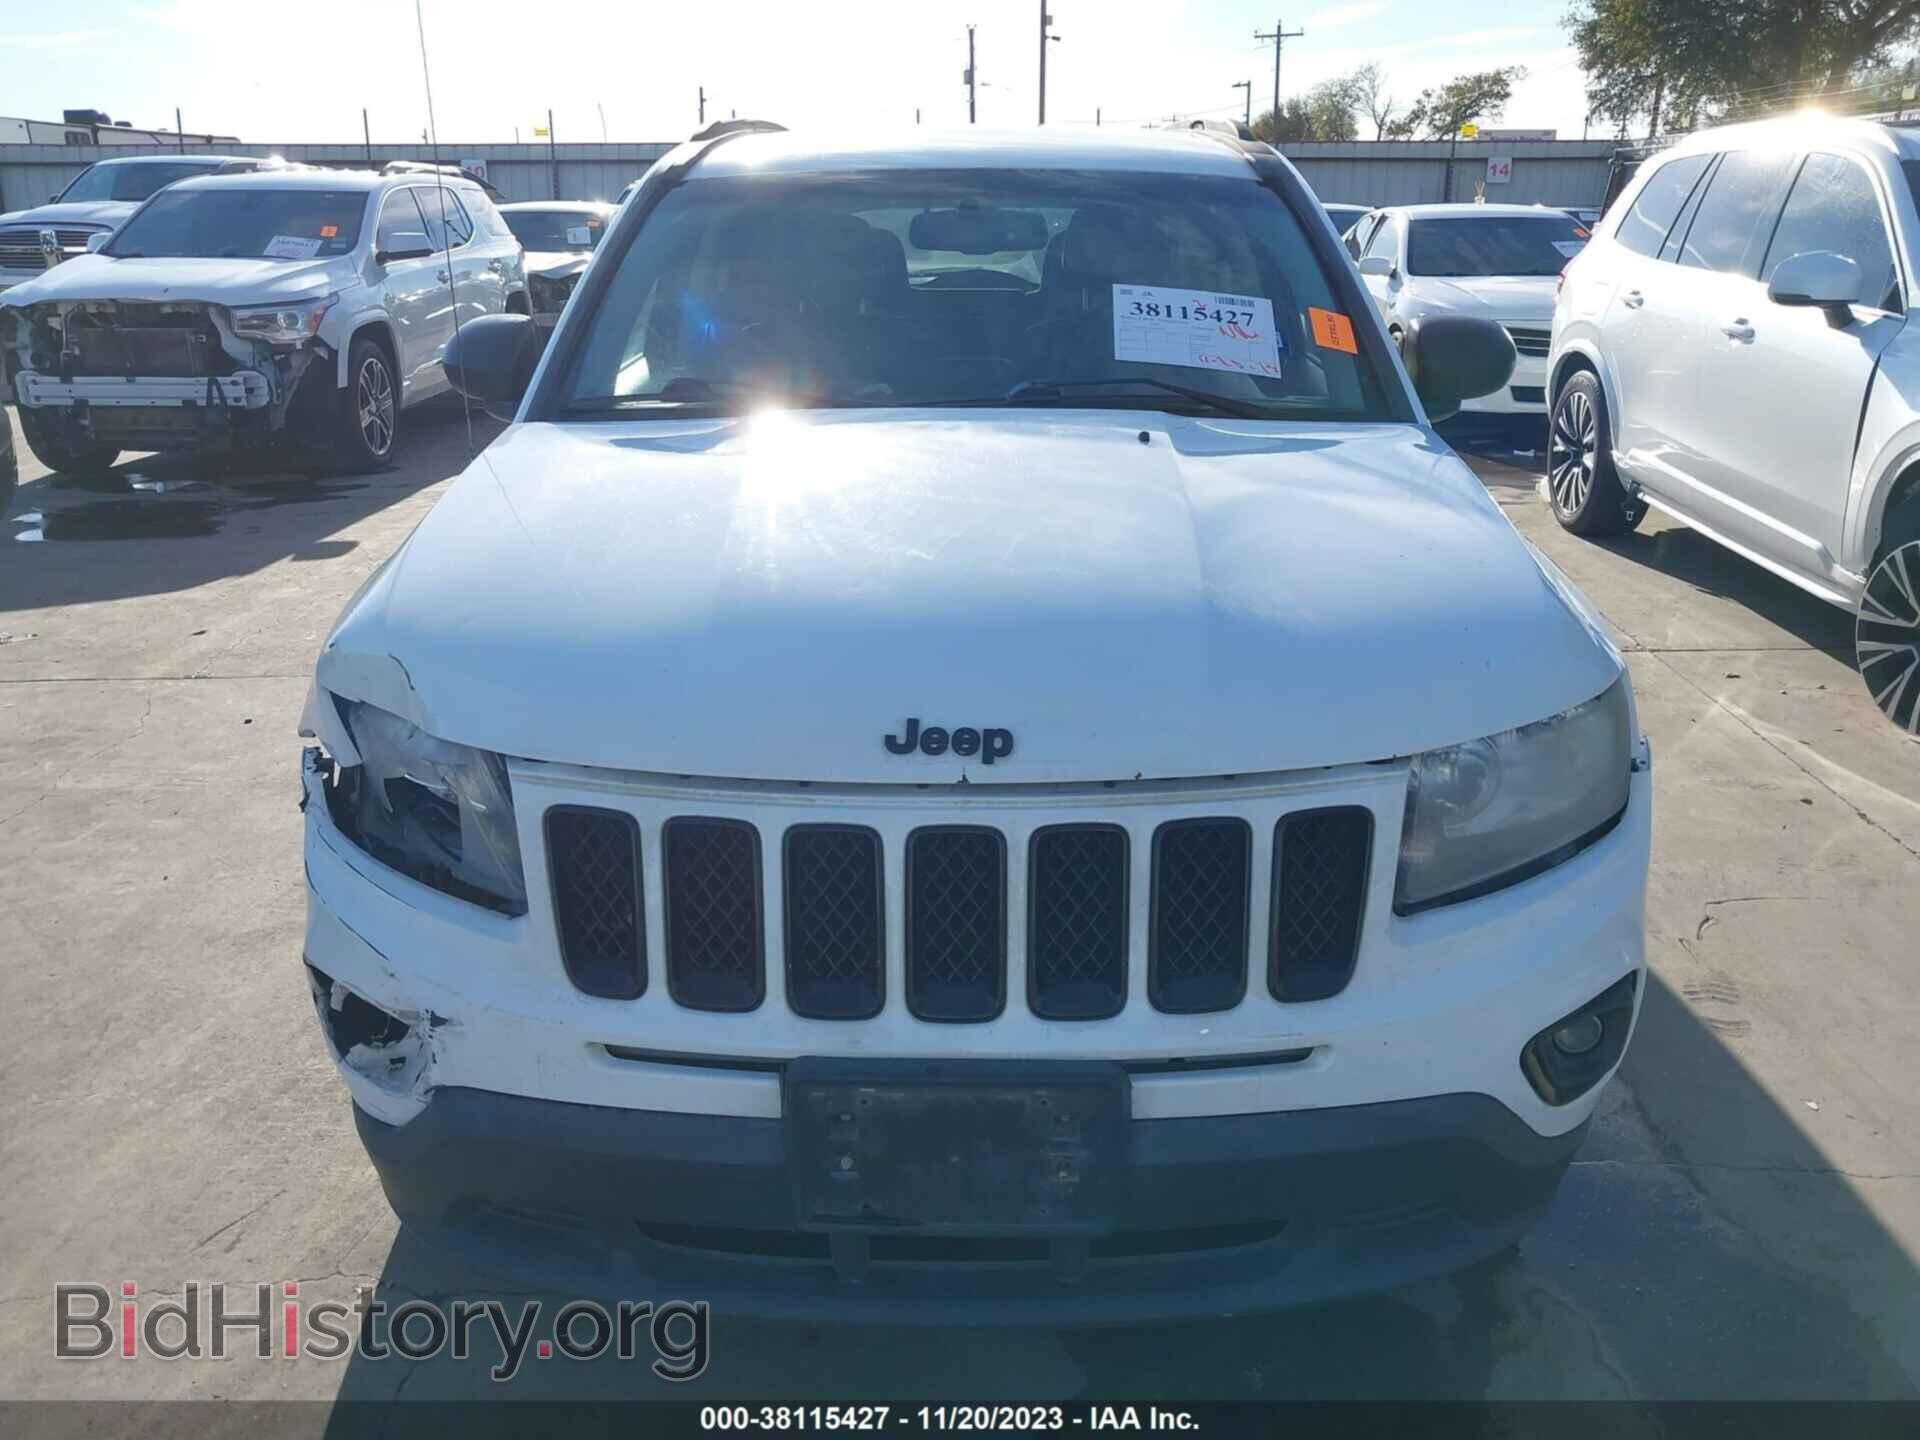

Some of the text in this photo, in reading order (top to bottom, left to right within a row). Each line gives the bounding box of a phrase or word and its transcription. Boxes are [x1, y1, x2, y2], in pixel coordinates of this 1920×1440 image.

[1489, 163, 1509, 176] 14
[1129, 302, 1254, 327] 38115427
[884, 718, 1014, 765] Jeep
